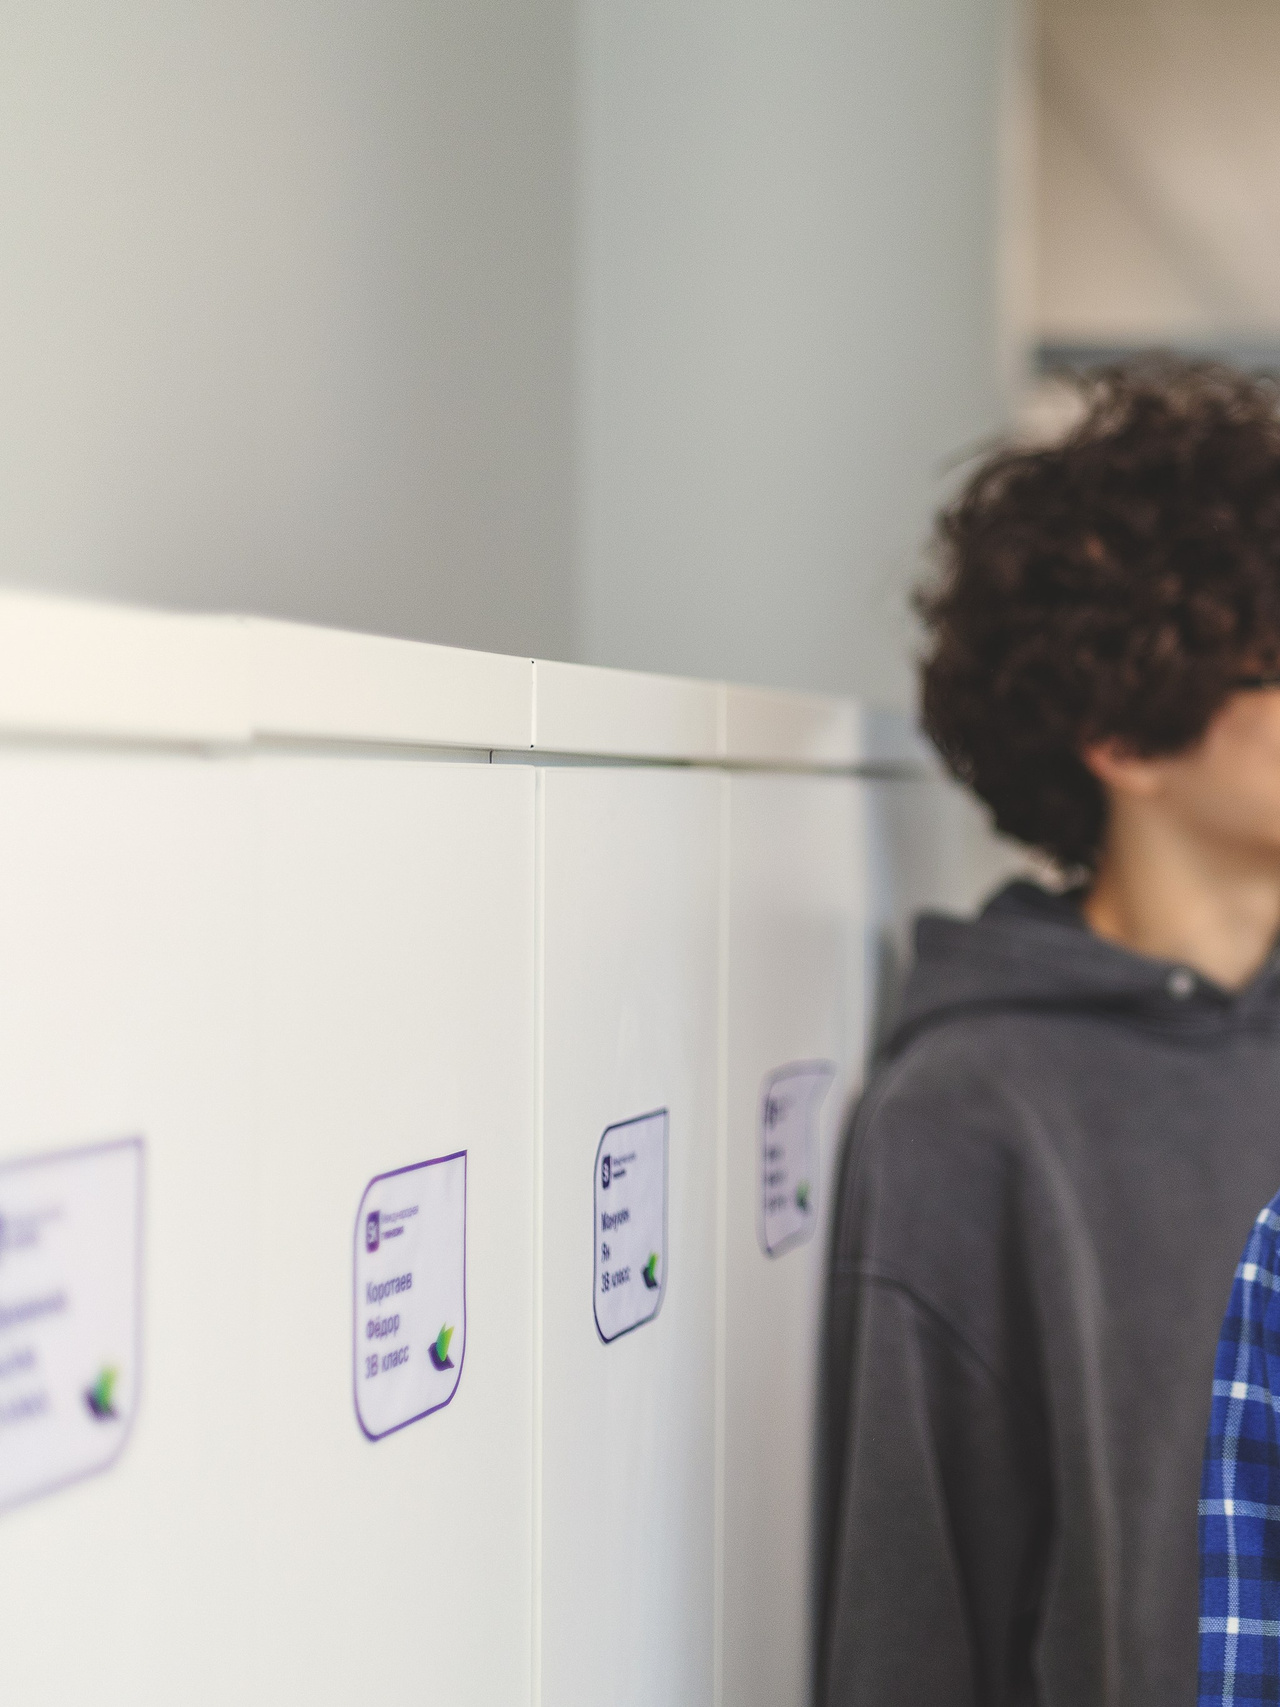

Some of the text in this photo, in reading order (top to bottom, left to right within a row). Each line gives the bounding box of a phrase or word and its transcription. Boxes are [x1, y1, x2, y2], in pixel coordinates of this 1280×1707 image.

[367, 1272, 412, 1304] Коротаев
[366, 1313, 400, 1340] Фёдор
[381, 1344, 410, 1373] класс
